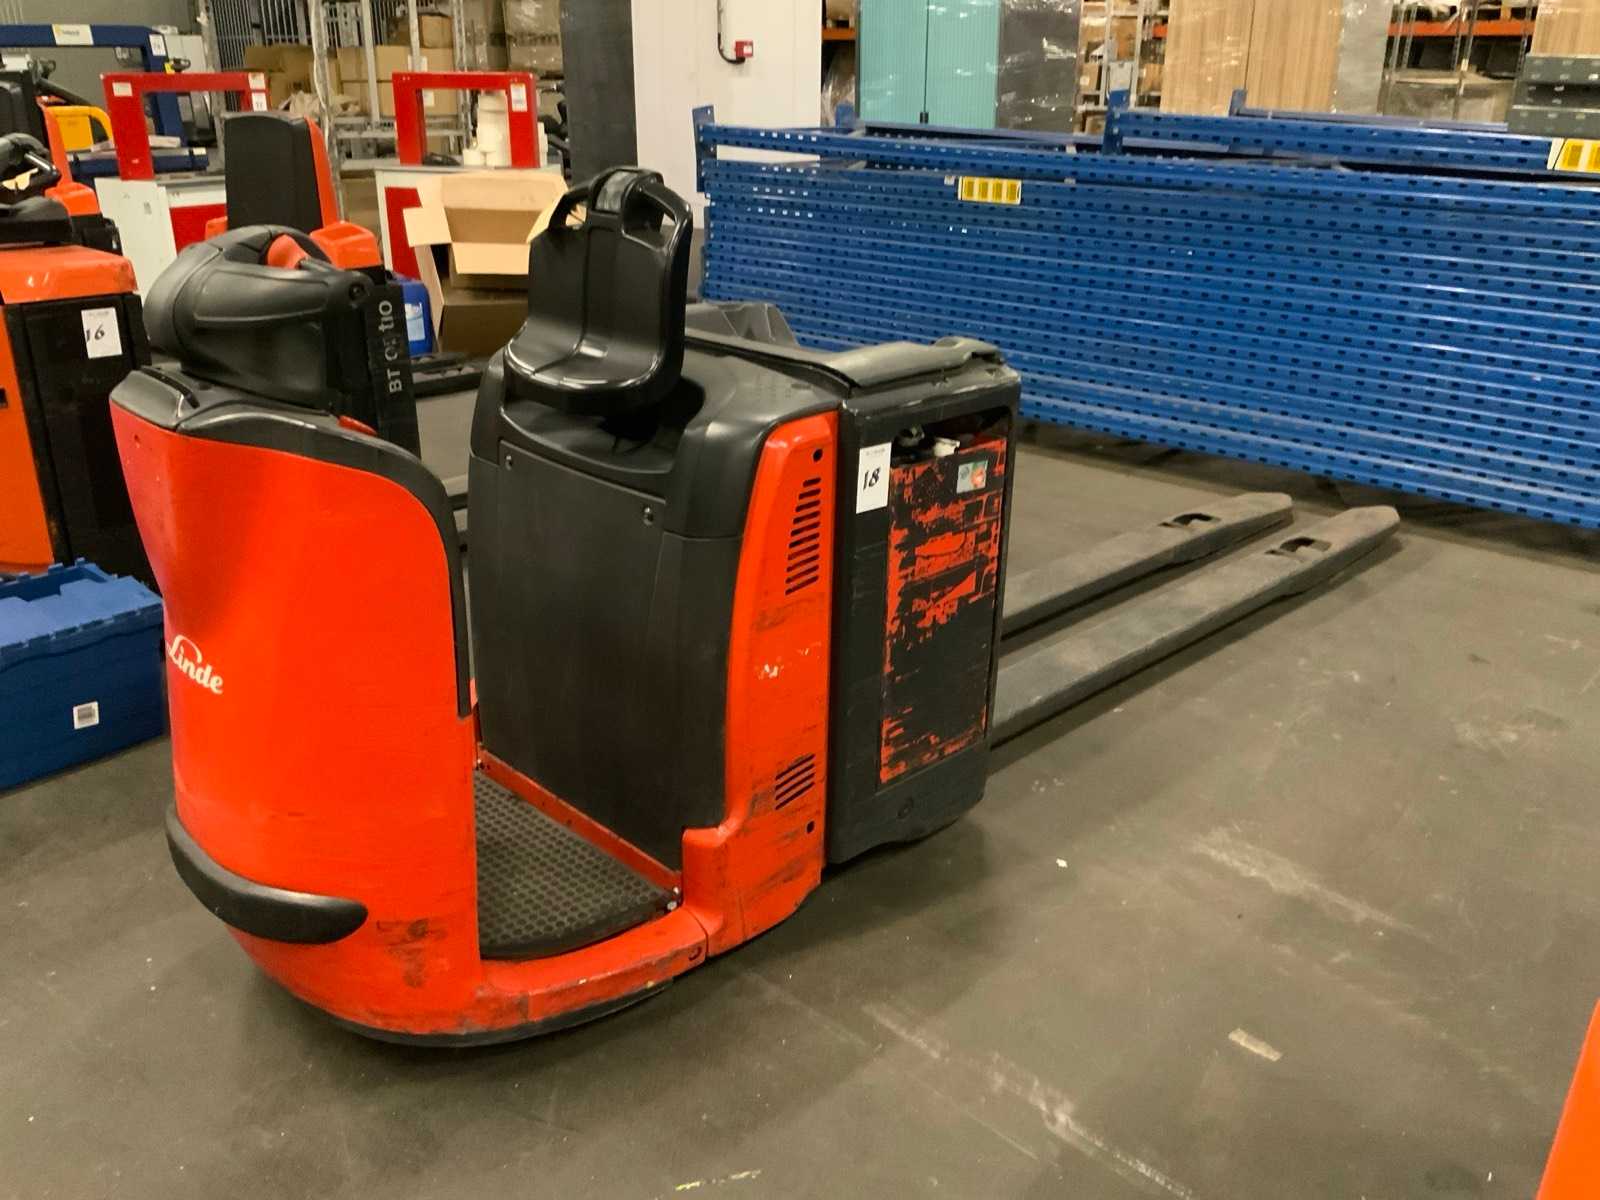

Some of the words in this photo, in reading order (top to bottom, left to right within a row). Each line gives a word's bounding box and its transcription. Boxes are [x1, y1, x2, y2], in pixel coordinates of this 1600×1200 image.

[86, 323, 105, 343] 16
[378, 300, 399, 362] Otio
[387, 367, 402, 394] BT
[862, 466, 881, 492] 18
[166, 634, 224, 695] Linde
